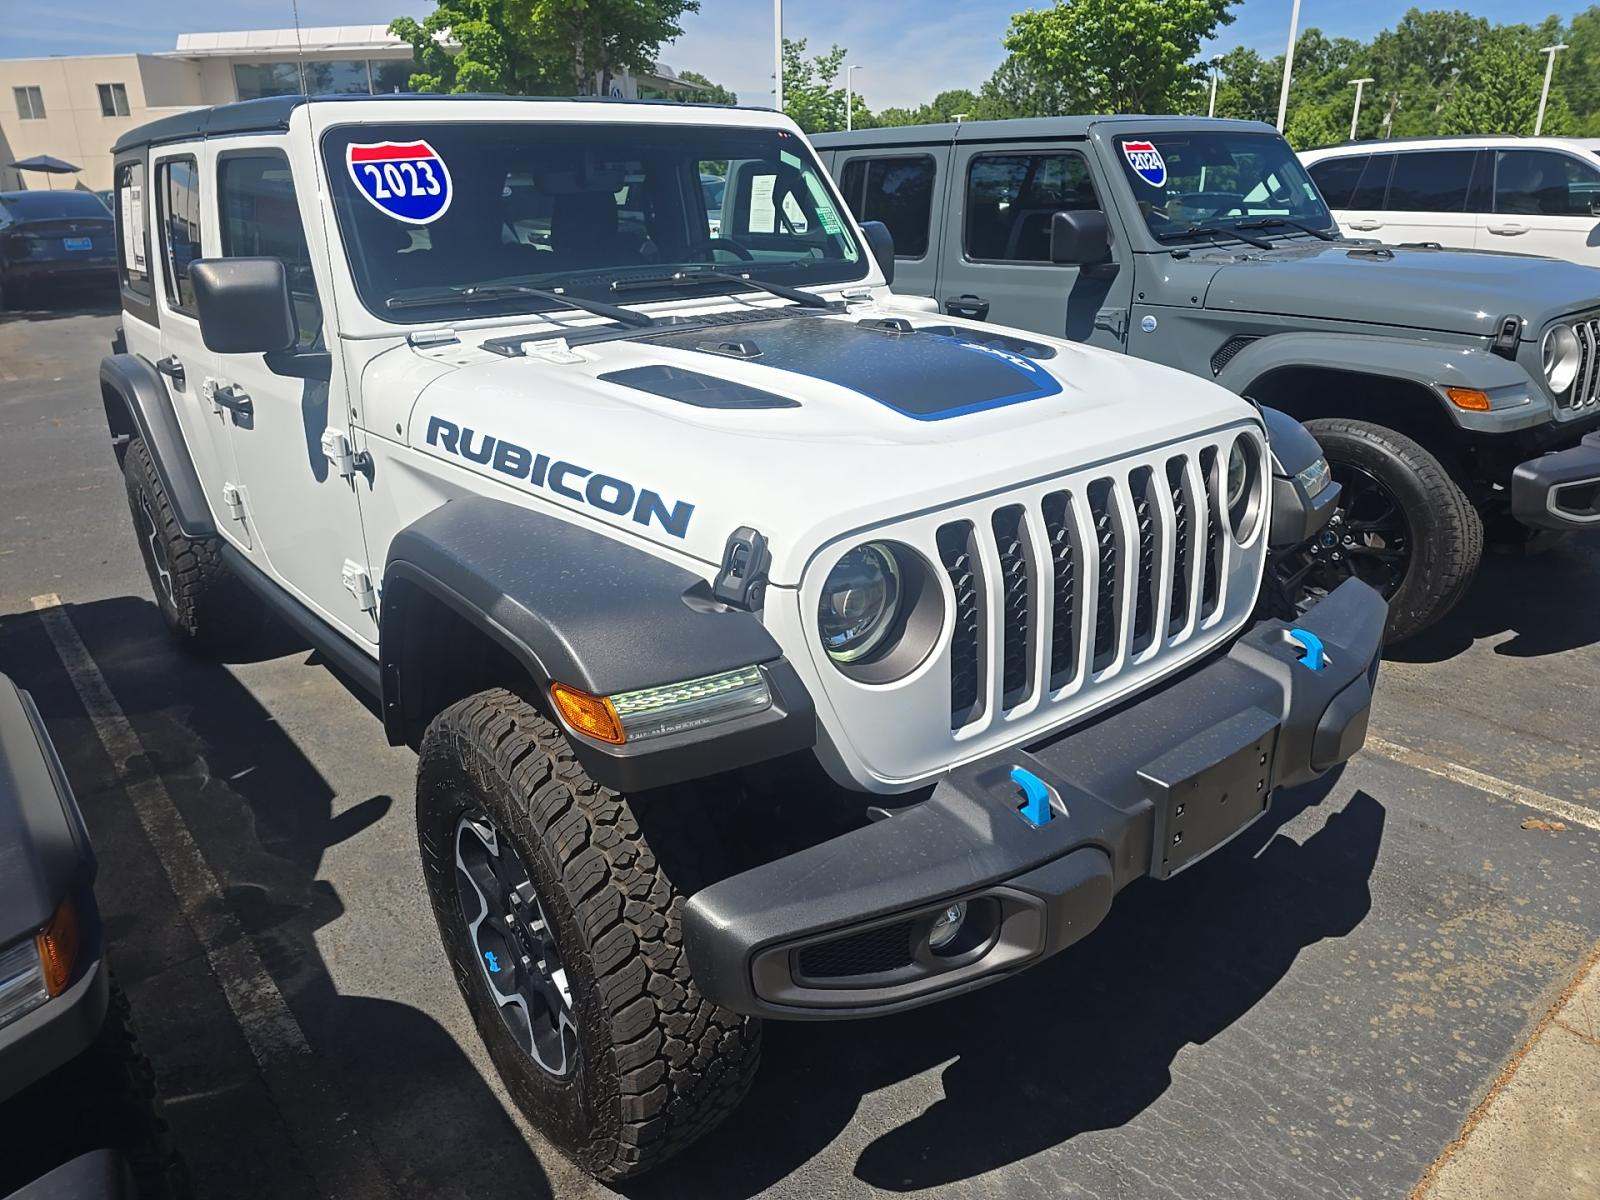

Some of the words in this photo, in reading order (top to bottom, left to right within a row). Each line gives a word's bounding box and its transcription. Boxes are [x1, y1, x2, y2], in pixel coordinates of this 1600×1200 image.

[364, 161, 441, 199] 2023
[1130, 152, 1162, 170] 2024
[426, 415, 695, 539] RUBICON
